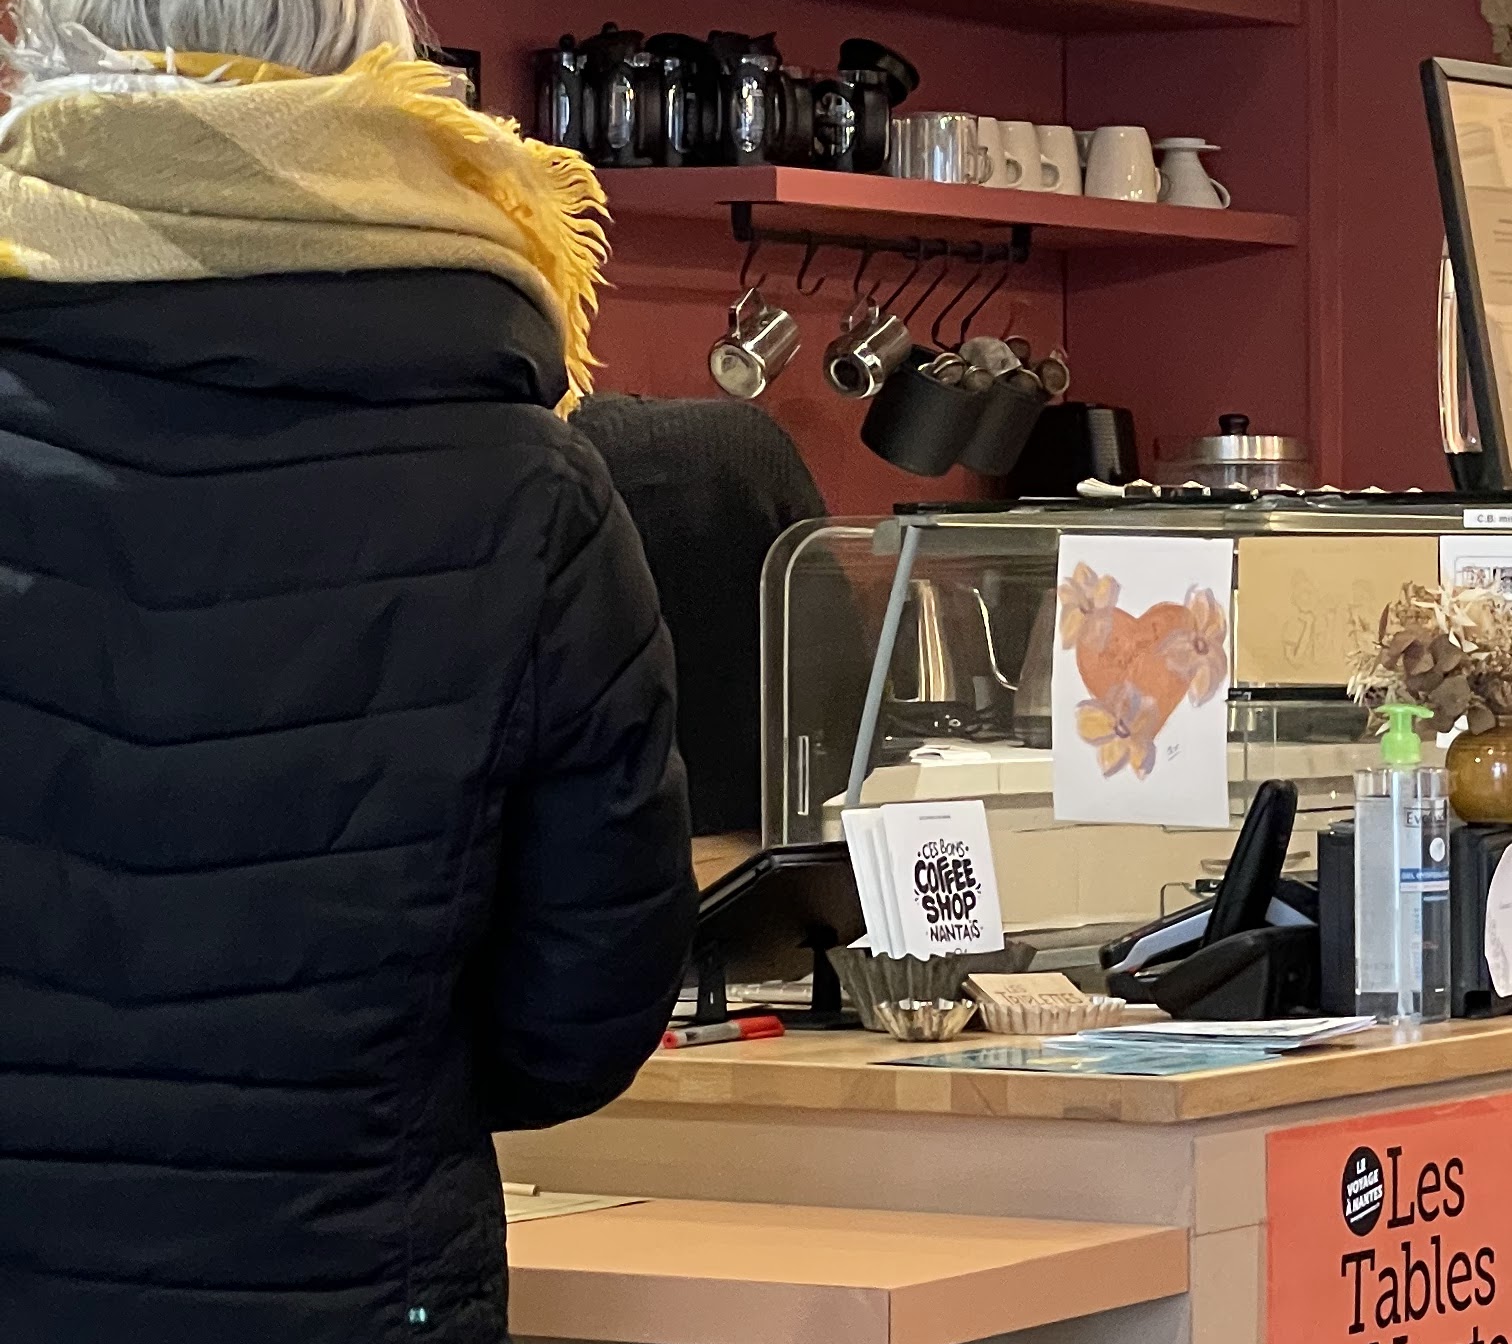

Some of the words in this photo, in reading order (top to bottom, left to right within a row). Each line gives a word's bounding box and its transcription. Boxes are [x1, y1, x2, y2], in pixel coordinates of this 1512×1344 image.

[922, 841, 939, 859] CES
[940, 838, 965, 857] BONS
[914, 856, 977, 895] COFFEE
[921, 890, 977, 924] SHOP
[1346, 1168, 1379, 1197] VOYAGE
[1352, 1184, 1383, 1213] NANTES
[1387, 1146, 1465, 1229] Les
[1341, 1234, 1497, 1335] Tables
